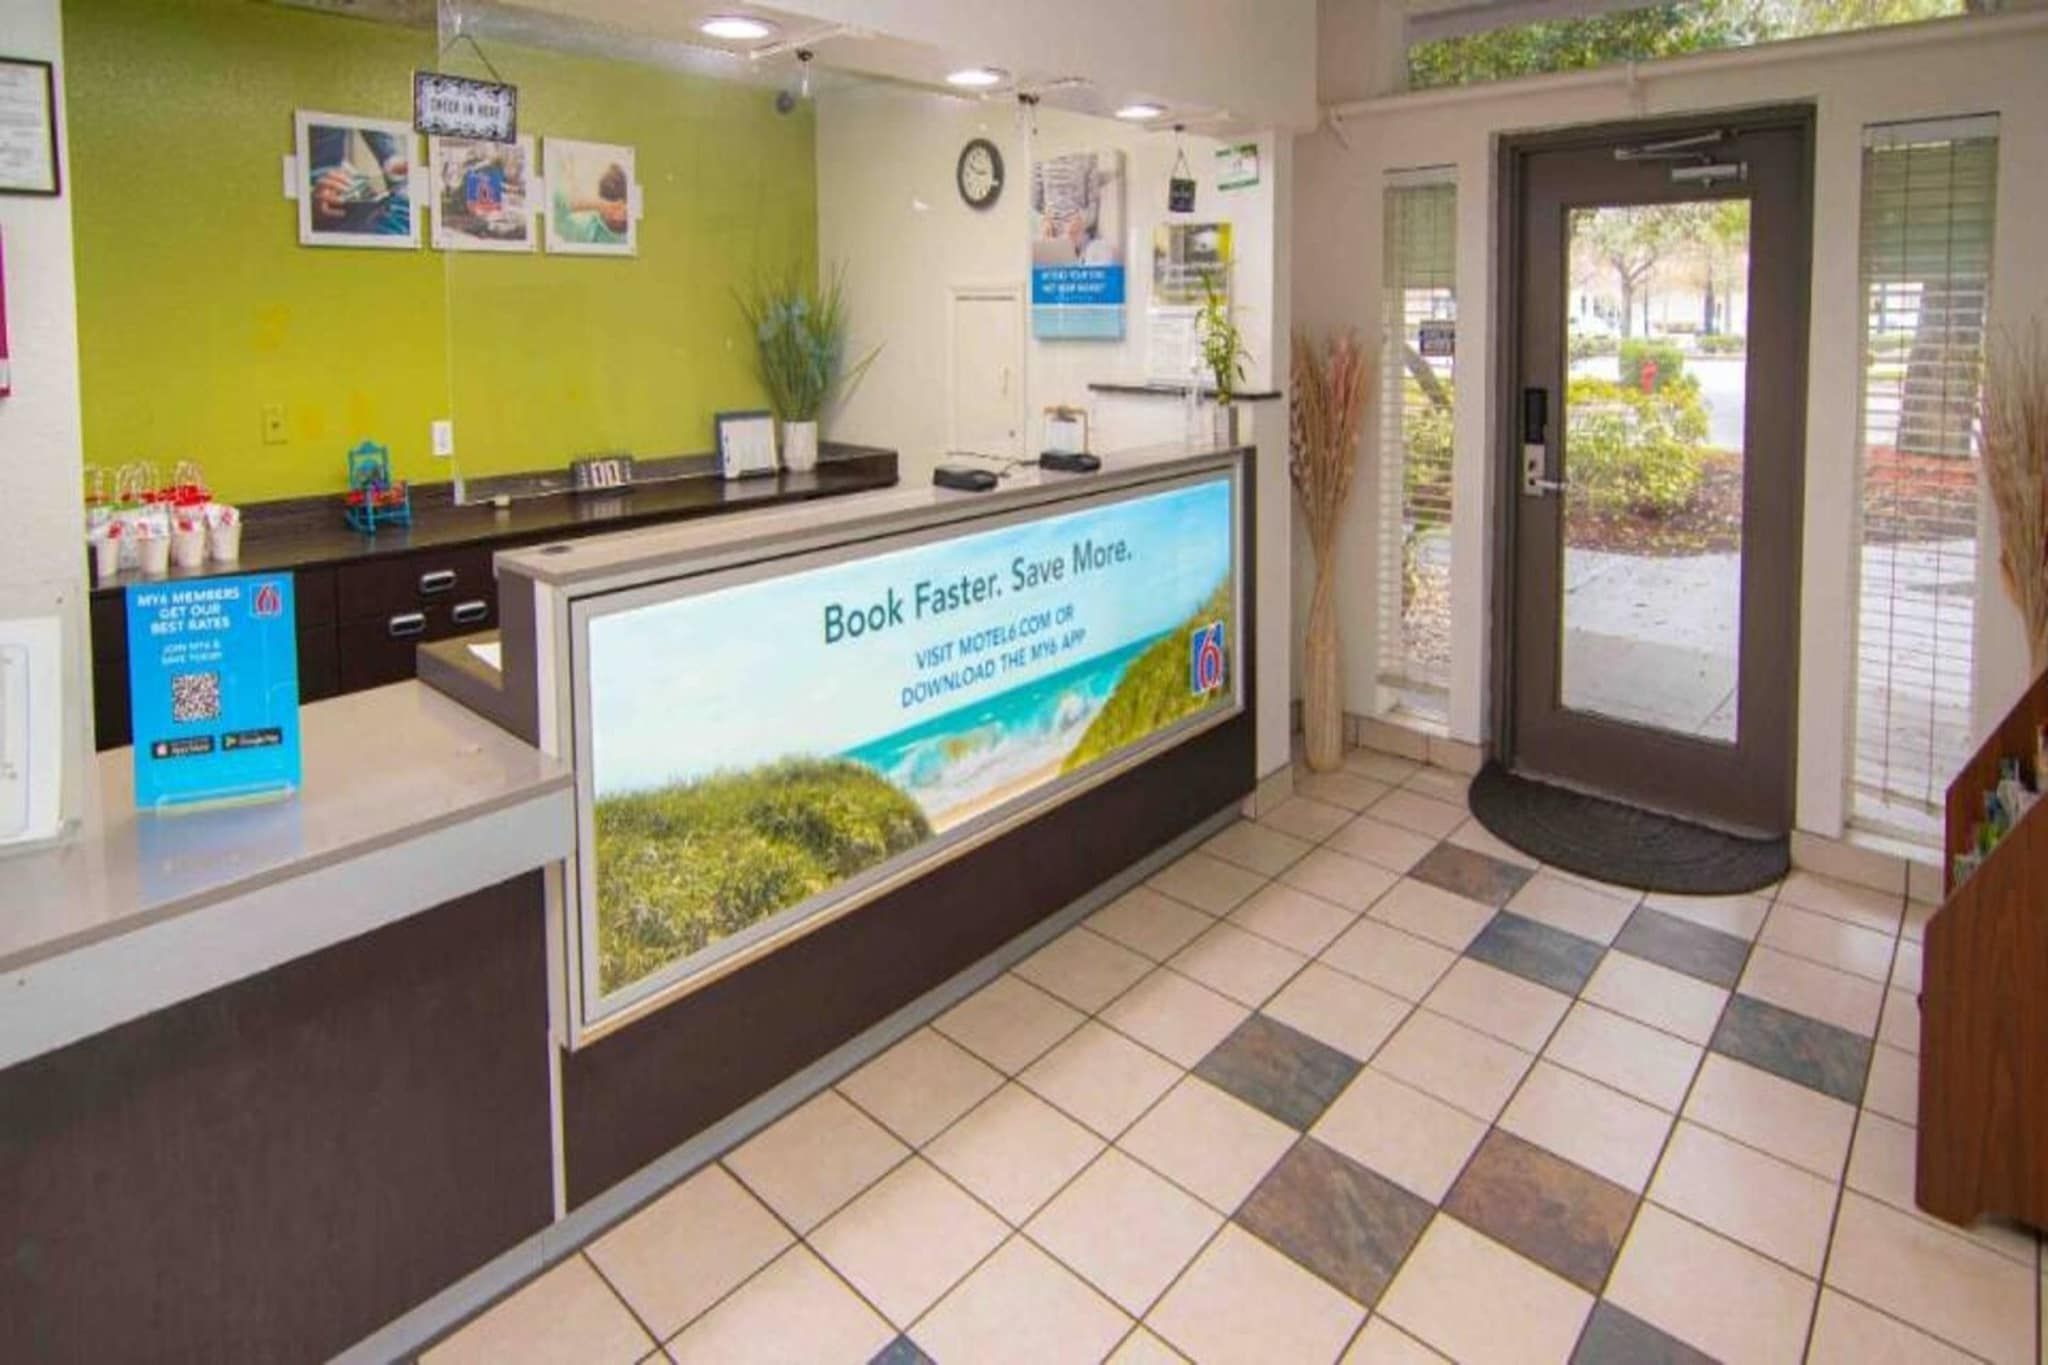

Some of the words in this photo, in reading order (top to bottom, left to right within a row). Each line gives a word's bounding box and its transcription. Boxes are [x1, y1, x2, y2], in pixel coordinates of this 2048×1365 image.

[159, 605, 187, 619] GET
[190, 602, 221, 617] OUR
[172, 586, 240, 604] MEMBERS
[824, 587, 904, 644] Book
[915, 574, 1003, 619] Faster.
[1012, 556, 1065, 592] Save
[1073, 538, 1133, 575] More.
[151, 620, 184, 635] BEST
[188, 616, 231, 631] RATES
[916, 642, 953, 669] VISIT
[959, 610, 1052, 656] MOTEL6.COM
[1056, 603, 1074, 625] OR
[901, 658, 996, 708] DOWNLOAD
[1001, 648, 1026, 672] THE
[1031, 637, 1057, 661] MY6
[1062, 627, 1087, 650] APP
